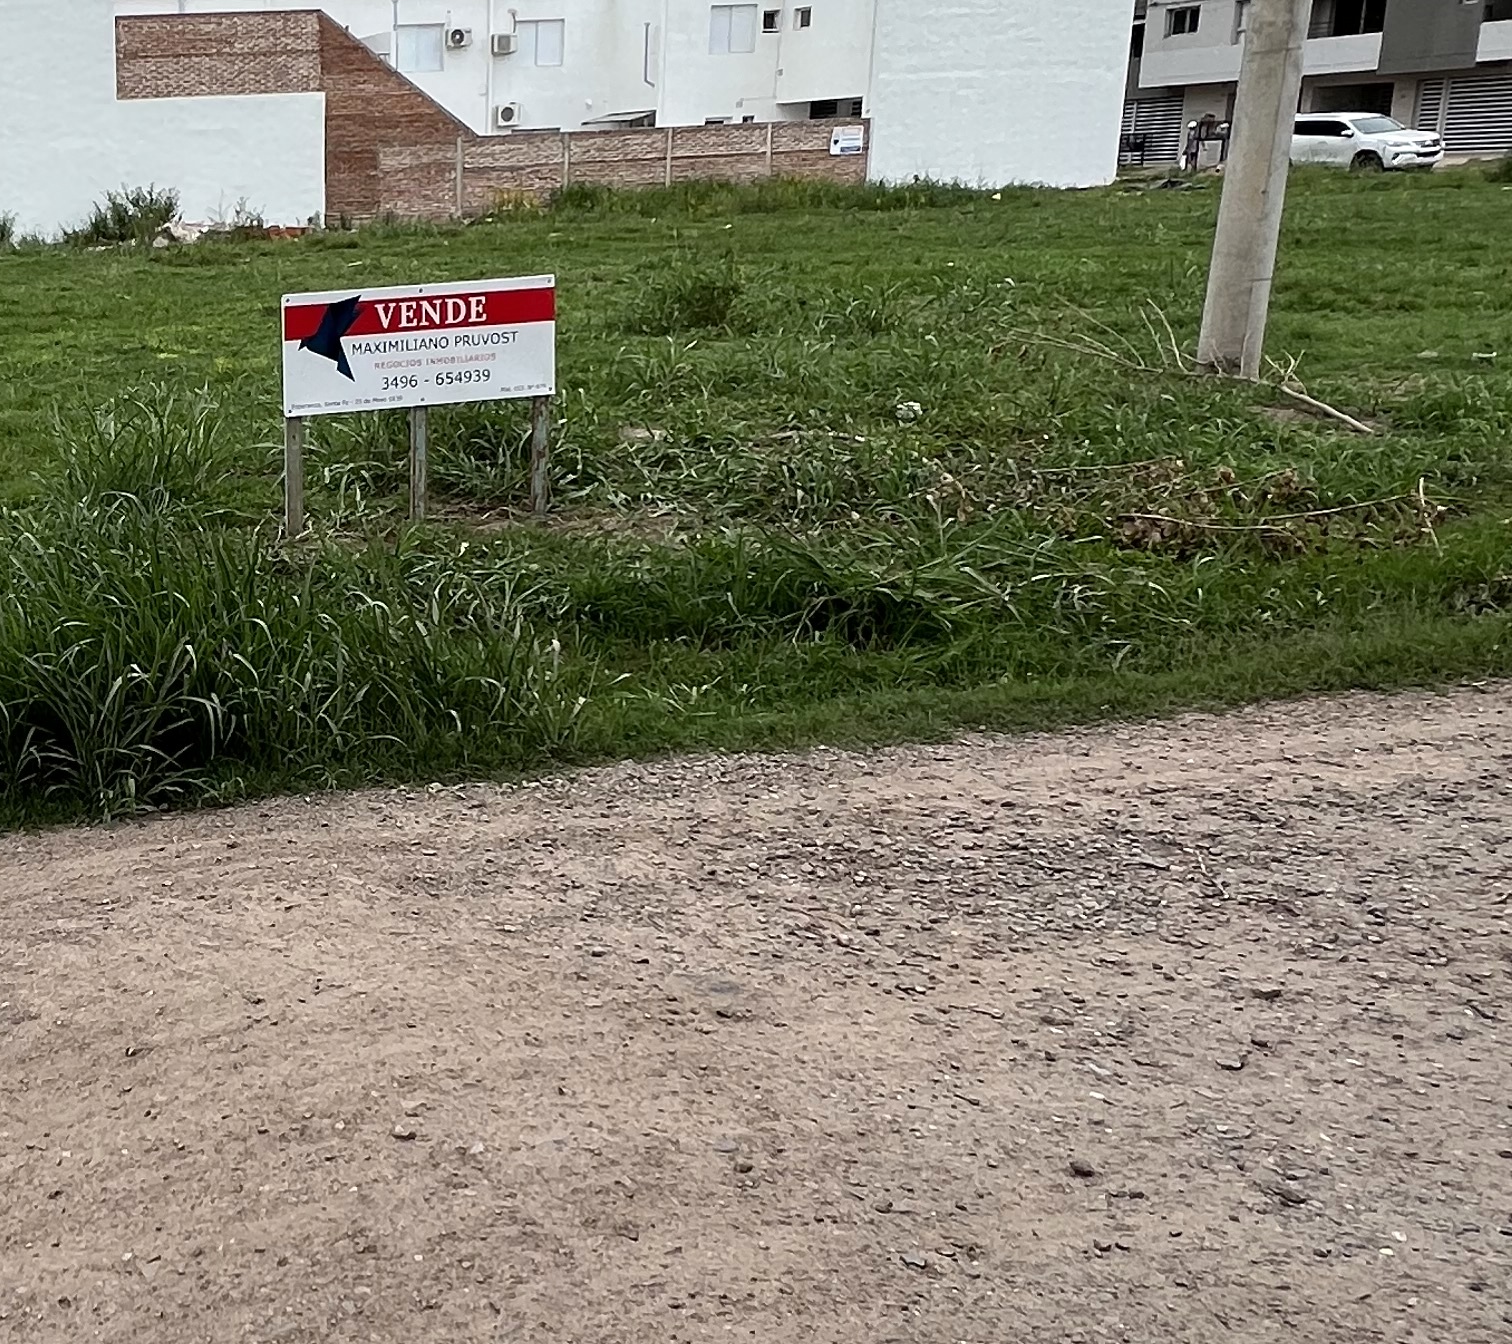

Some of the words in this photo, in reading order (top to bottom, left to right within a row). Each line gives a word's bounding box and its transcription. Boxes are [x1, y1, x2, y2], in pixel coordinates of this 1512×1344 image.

[374, 295, 487, 329] VENDE
[352, 336, 449, 355] MAXIMILIANO
[454, 331, 519, 347] PRUVOST
[381, 374, 419, 391] 3496
[435, 369, 491, 386] 654939
